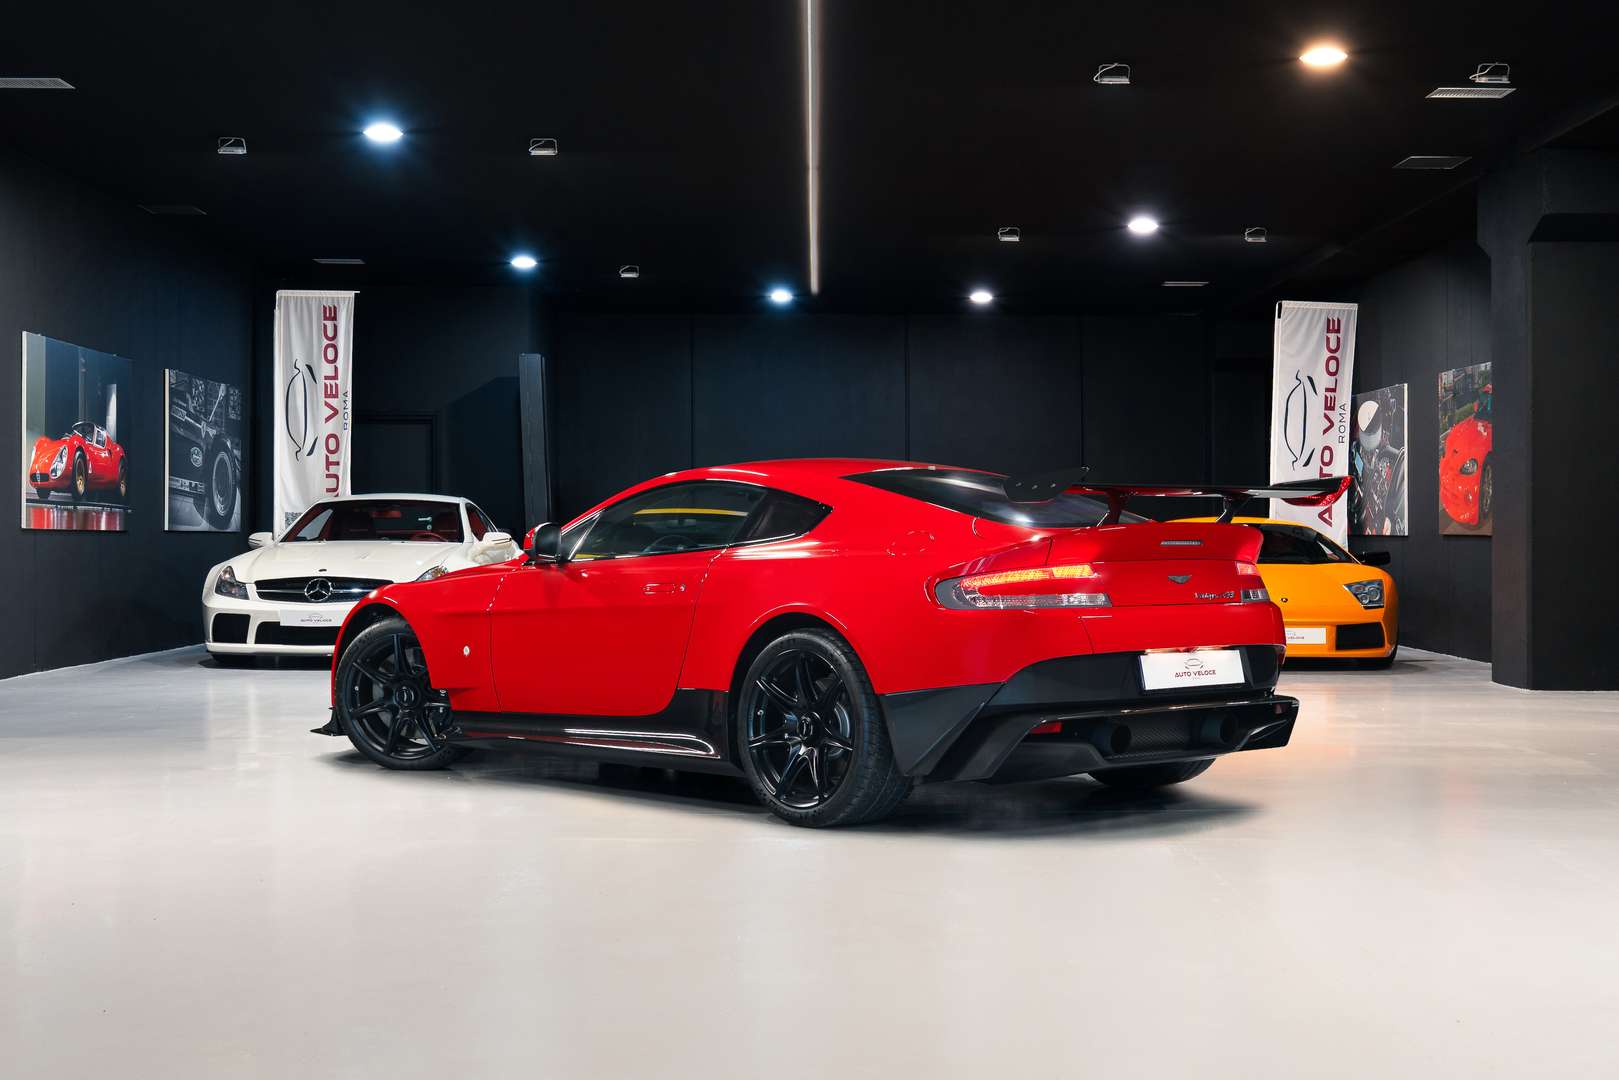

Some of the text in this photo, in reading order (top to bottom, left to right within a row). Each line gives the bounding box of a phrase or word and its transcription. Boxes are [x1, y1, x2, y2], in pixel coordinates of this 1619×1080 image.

[322, 304, 341, 497] UTO VELOCE
[1317, 316, 1341, 528] ATO VELOCE
[1338, 403, 1347, 444] ROMA
[1192, 669, 1217, 677] VELOCE
